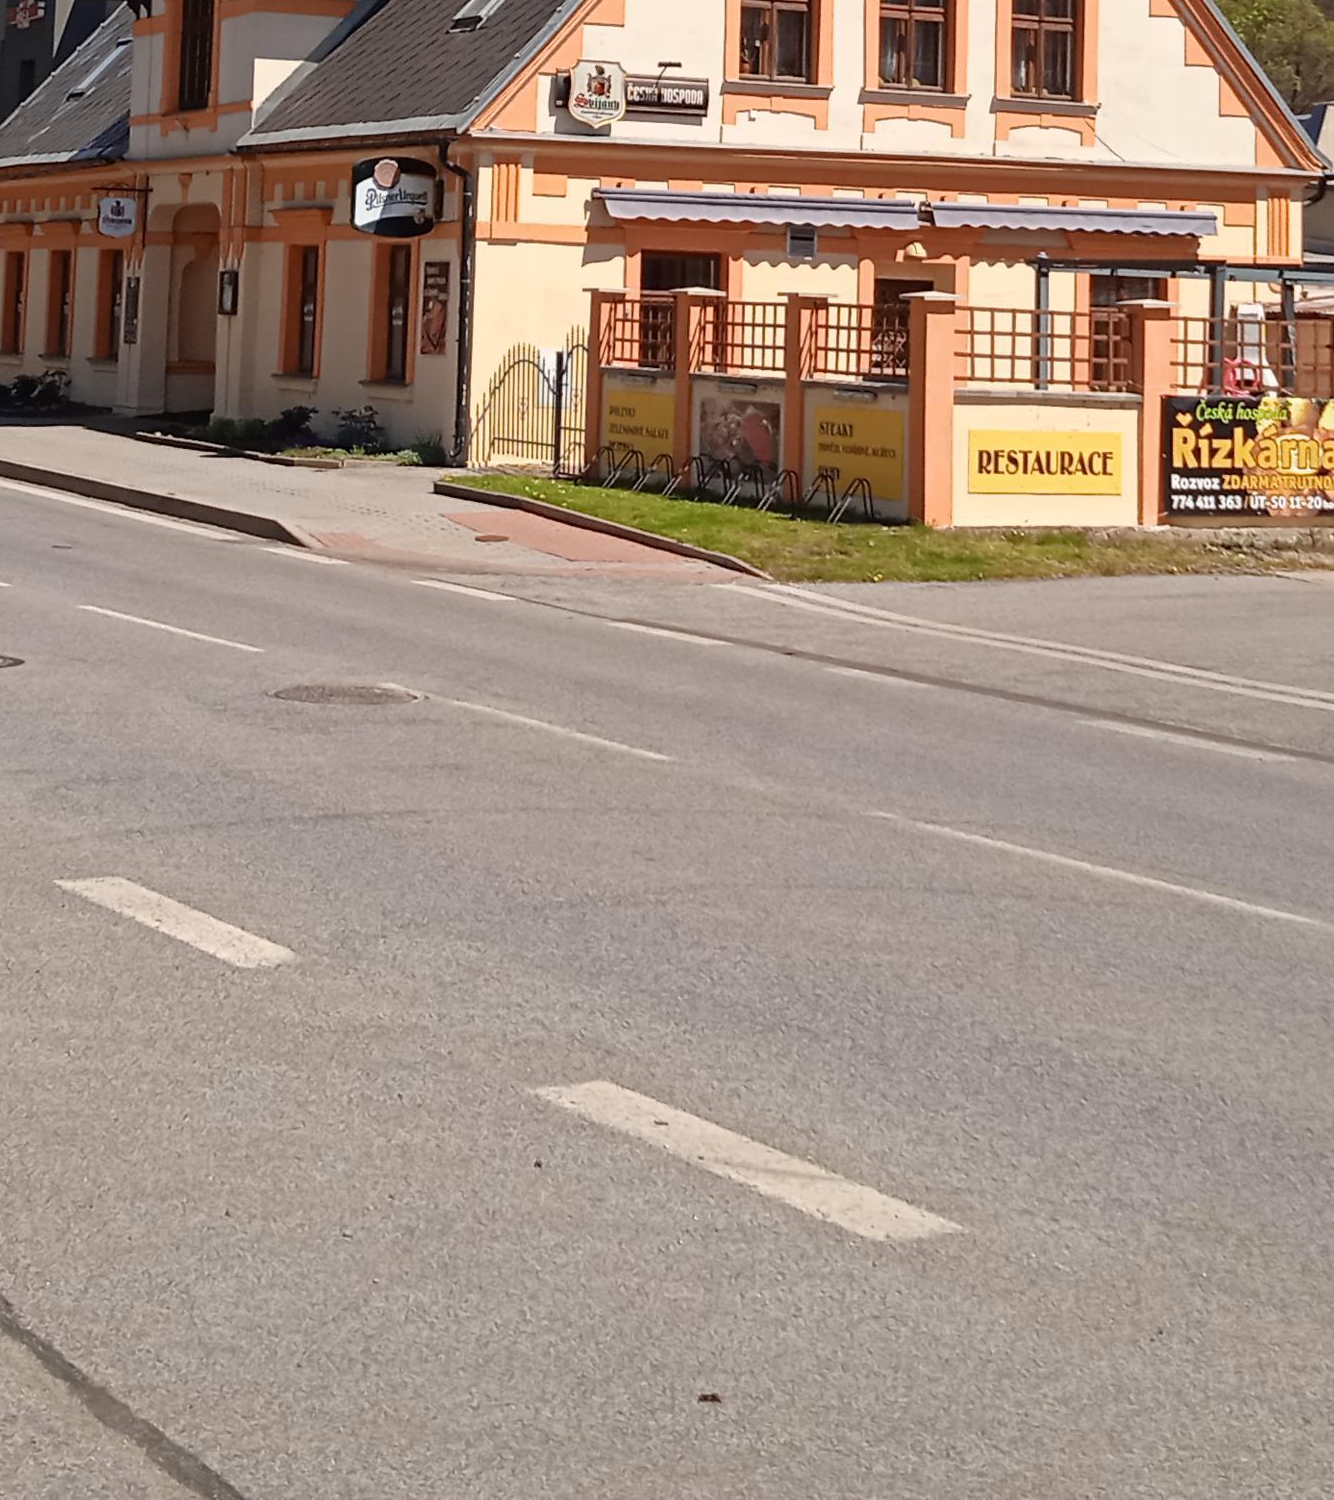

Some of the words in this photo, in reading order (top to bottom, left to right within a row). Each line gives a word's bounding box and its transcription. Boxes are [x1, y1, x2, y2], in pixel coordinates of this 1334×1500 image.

[661, 88, 703, 105] HOSPODA
[1196, 399, 1233, 423] Česká
[978, 449, 1113, 476] RESTAURACE
[1171, 473, 1220, 490] Rozvoz
[1222, 475, 1277, 490] ZDARMA
[1171, 495, 1194, 510] 774
[1196, 496, 1216, 510] 411
[1218, 495, 1242, 510] 363
